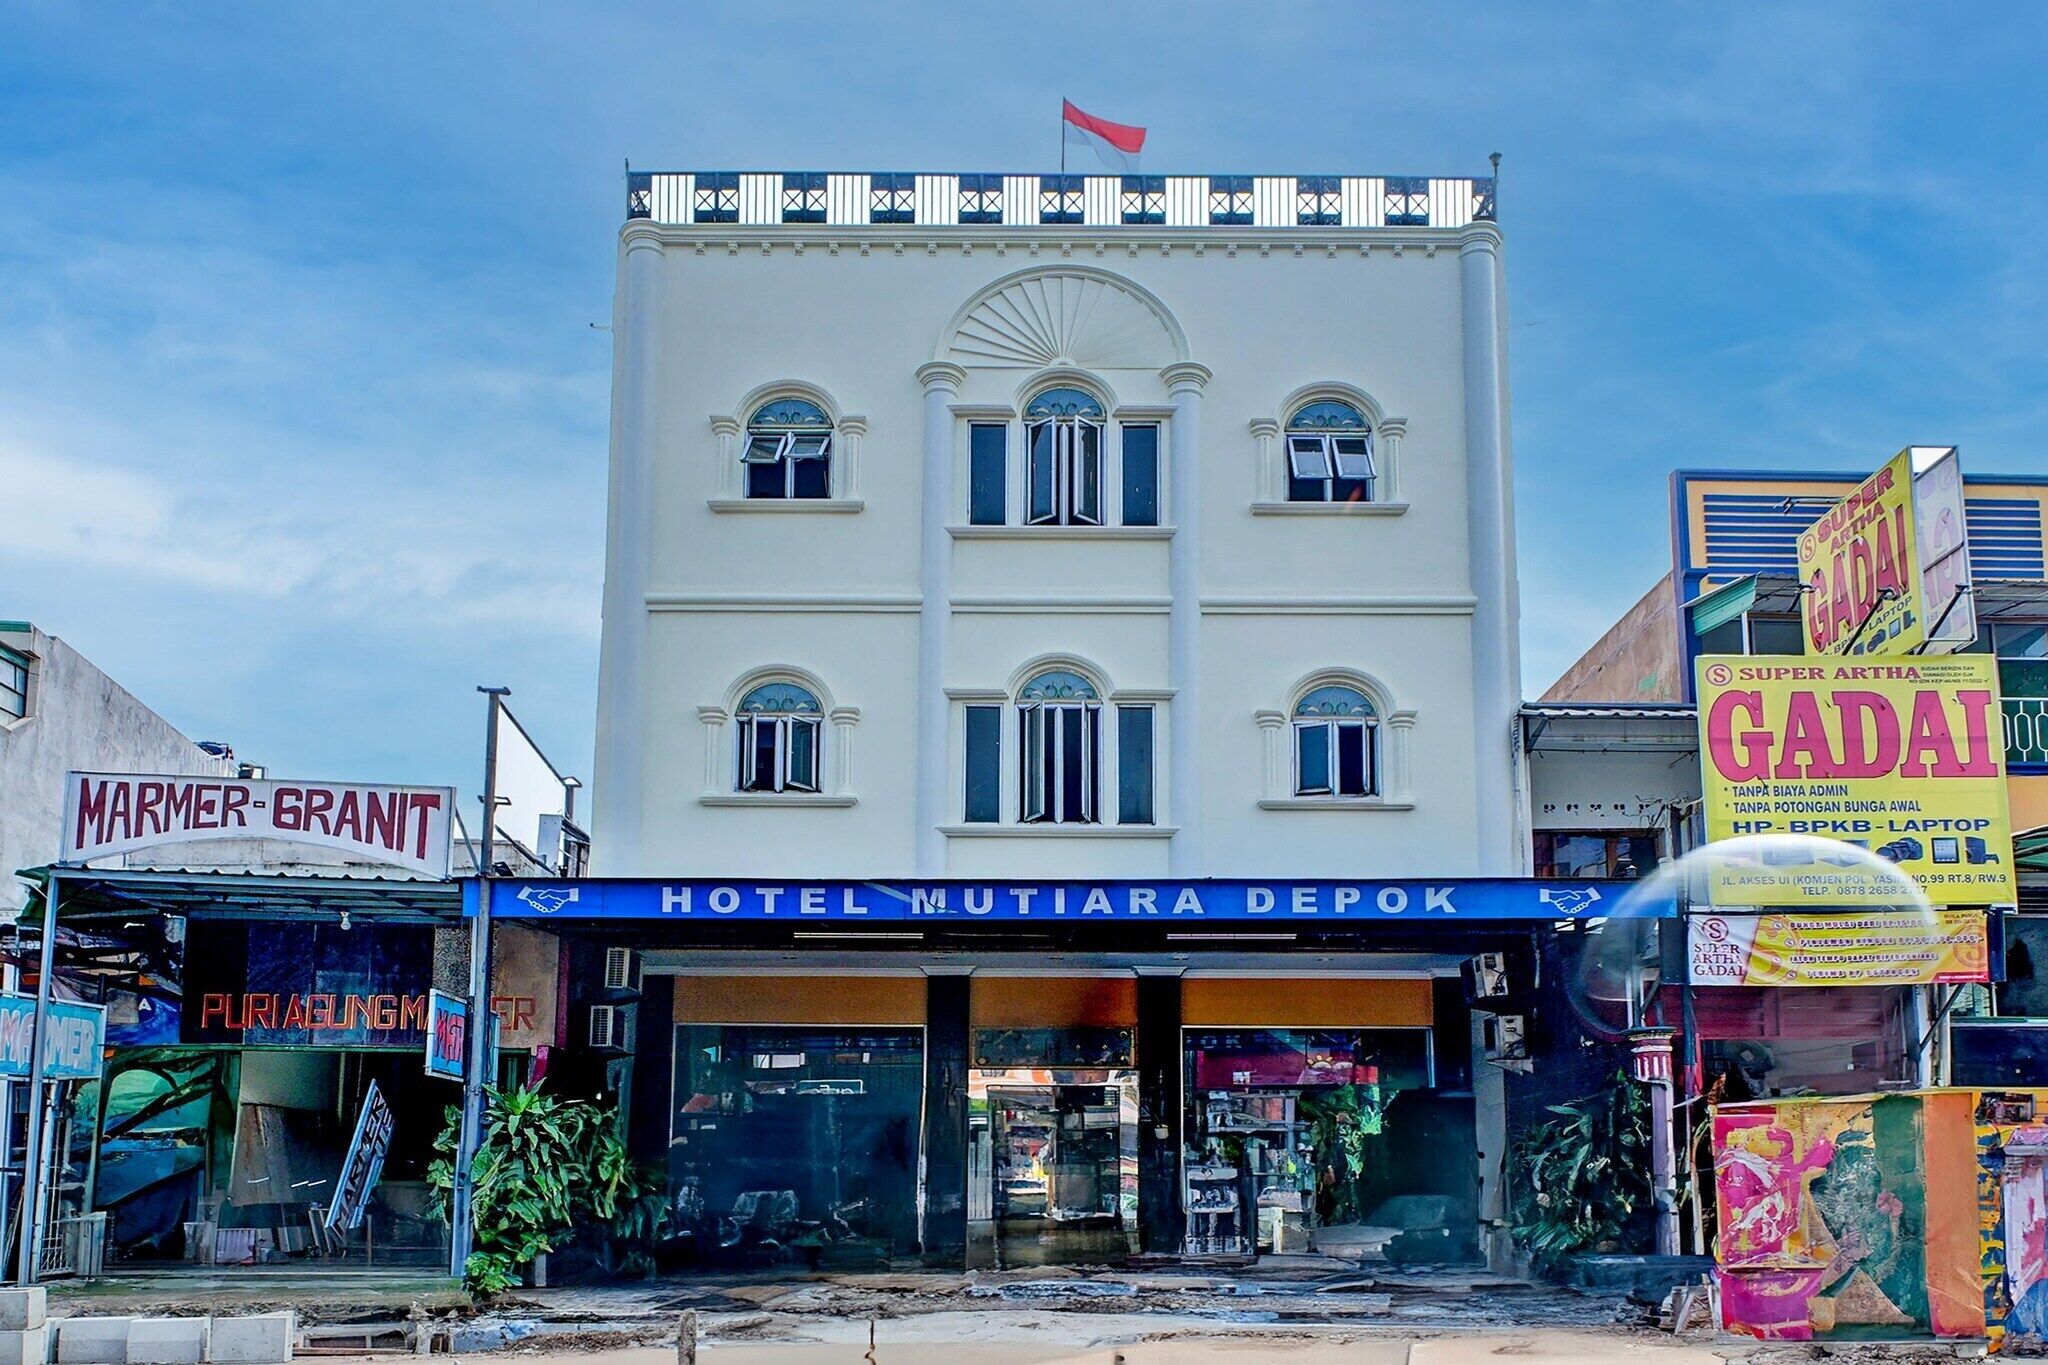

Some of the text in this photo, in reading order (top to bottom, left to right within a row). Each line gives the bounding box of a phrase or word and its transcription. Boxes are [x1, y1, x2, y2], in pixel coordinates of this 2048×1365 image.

[1817, 467, 1895, 544] SUPER
[1830, 501, 1885, 555] ARTHA
[1808, 503, 1909, 653] GADAI
[1739, 667, 1826, 681] SUPER
[1833, 666, 1921, 681] ARTHA
[1707, 689, 1998, 782] GADAI
[1732, 785, 1848, 797] TANPA BIAYA ADMIN
[1734, 800, 1922, 814] TANPA POTONGAN BUNGA AWAL
[1721, 876, 1735, 886] JL.
[1738, 875, 1775, 885] AKSES
[1778, 875, 1790, 885] UI
[1793, 874, 1842, 886] (KOMJEN
[1844, 875, 1868, 885] POL.
[1911, 874, 1946, 885] NO.99
[1948, 873, 2007, 886] RT.8/RW.9
[1801, 886, 1830, 895] TELP.
[1837, 885, 1865, 895] 0878
[1868, 885, 1898, 895] 2658
[661, 886, 1457, 914] HOTEL MUTIARA DEPOK
[1790, 921, 1822, 930] BUNGA
[1825, 920, 1855, 930] MULAI
[1857, 919, 1880, 929] DARI
[1694, 943, 1740, 954] SUPER
[1800, 938, 1853, 947] PINJAMAN
[1817, 954, 1846, 964] TEMPO
[1847, 954, 1874, 963] DAPAT
[1694, 965, 1745, 976] GADAI
